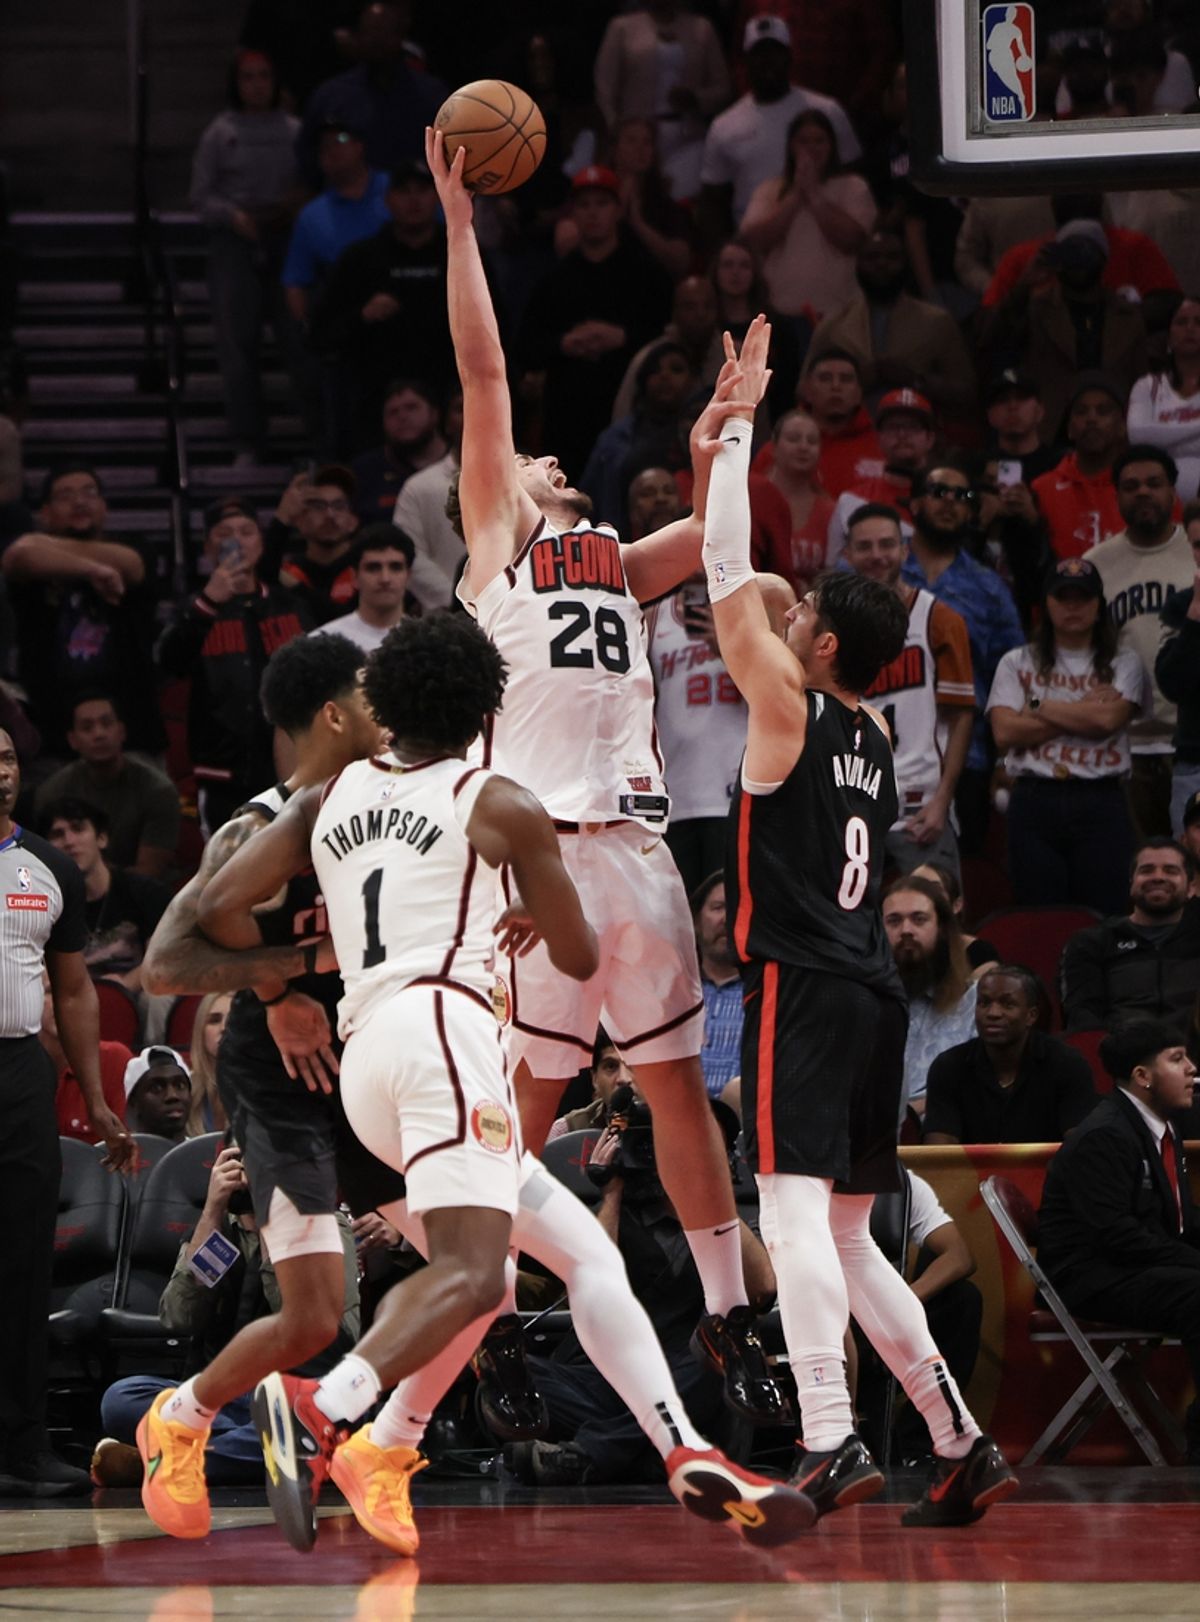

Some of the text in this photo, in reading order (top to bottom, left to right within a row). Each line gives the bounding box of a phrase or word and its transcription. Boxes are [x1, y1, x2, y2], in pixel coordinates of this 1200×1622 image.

[992, 96, 1016, 115] NBA
[548, 600, 631, 674] 28
[832, 753, 882, 800] AVDIJA
[321, 807, 443, 861] THOMPSON
[837, 815, 870, 911] 8
[7, 896, 48, 908] Emirates
[360, 867, 386, 969] 1
